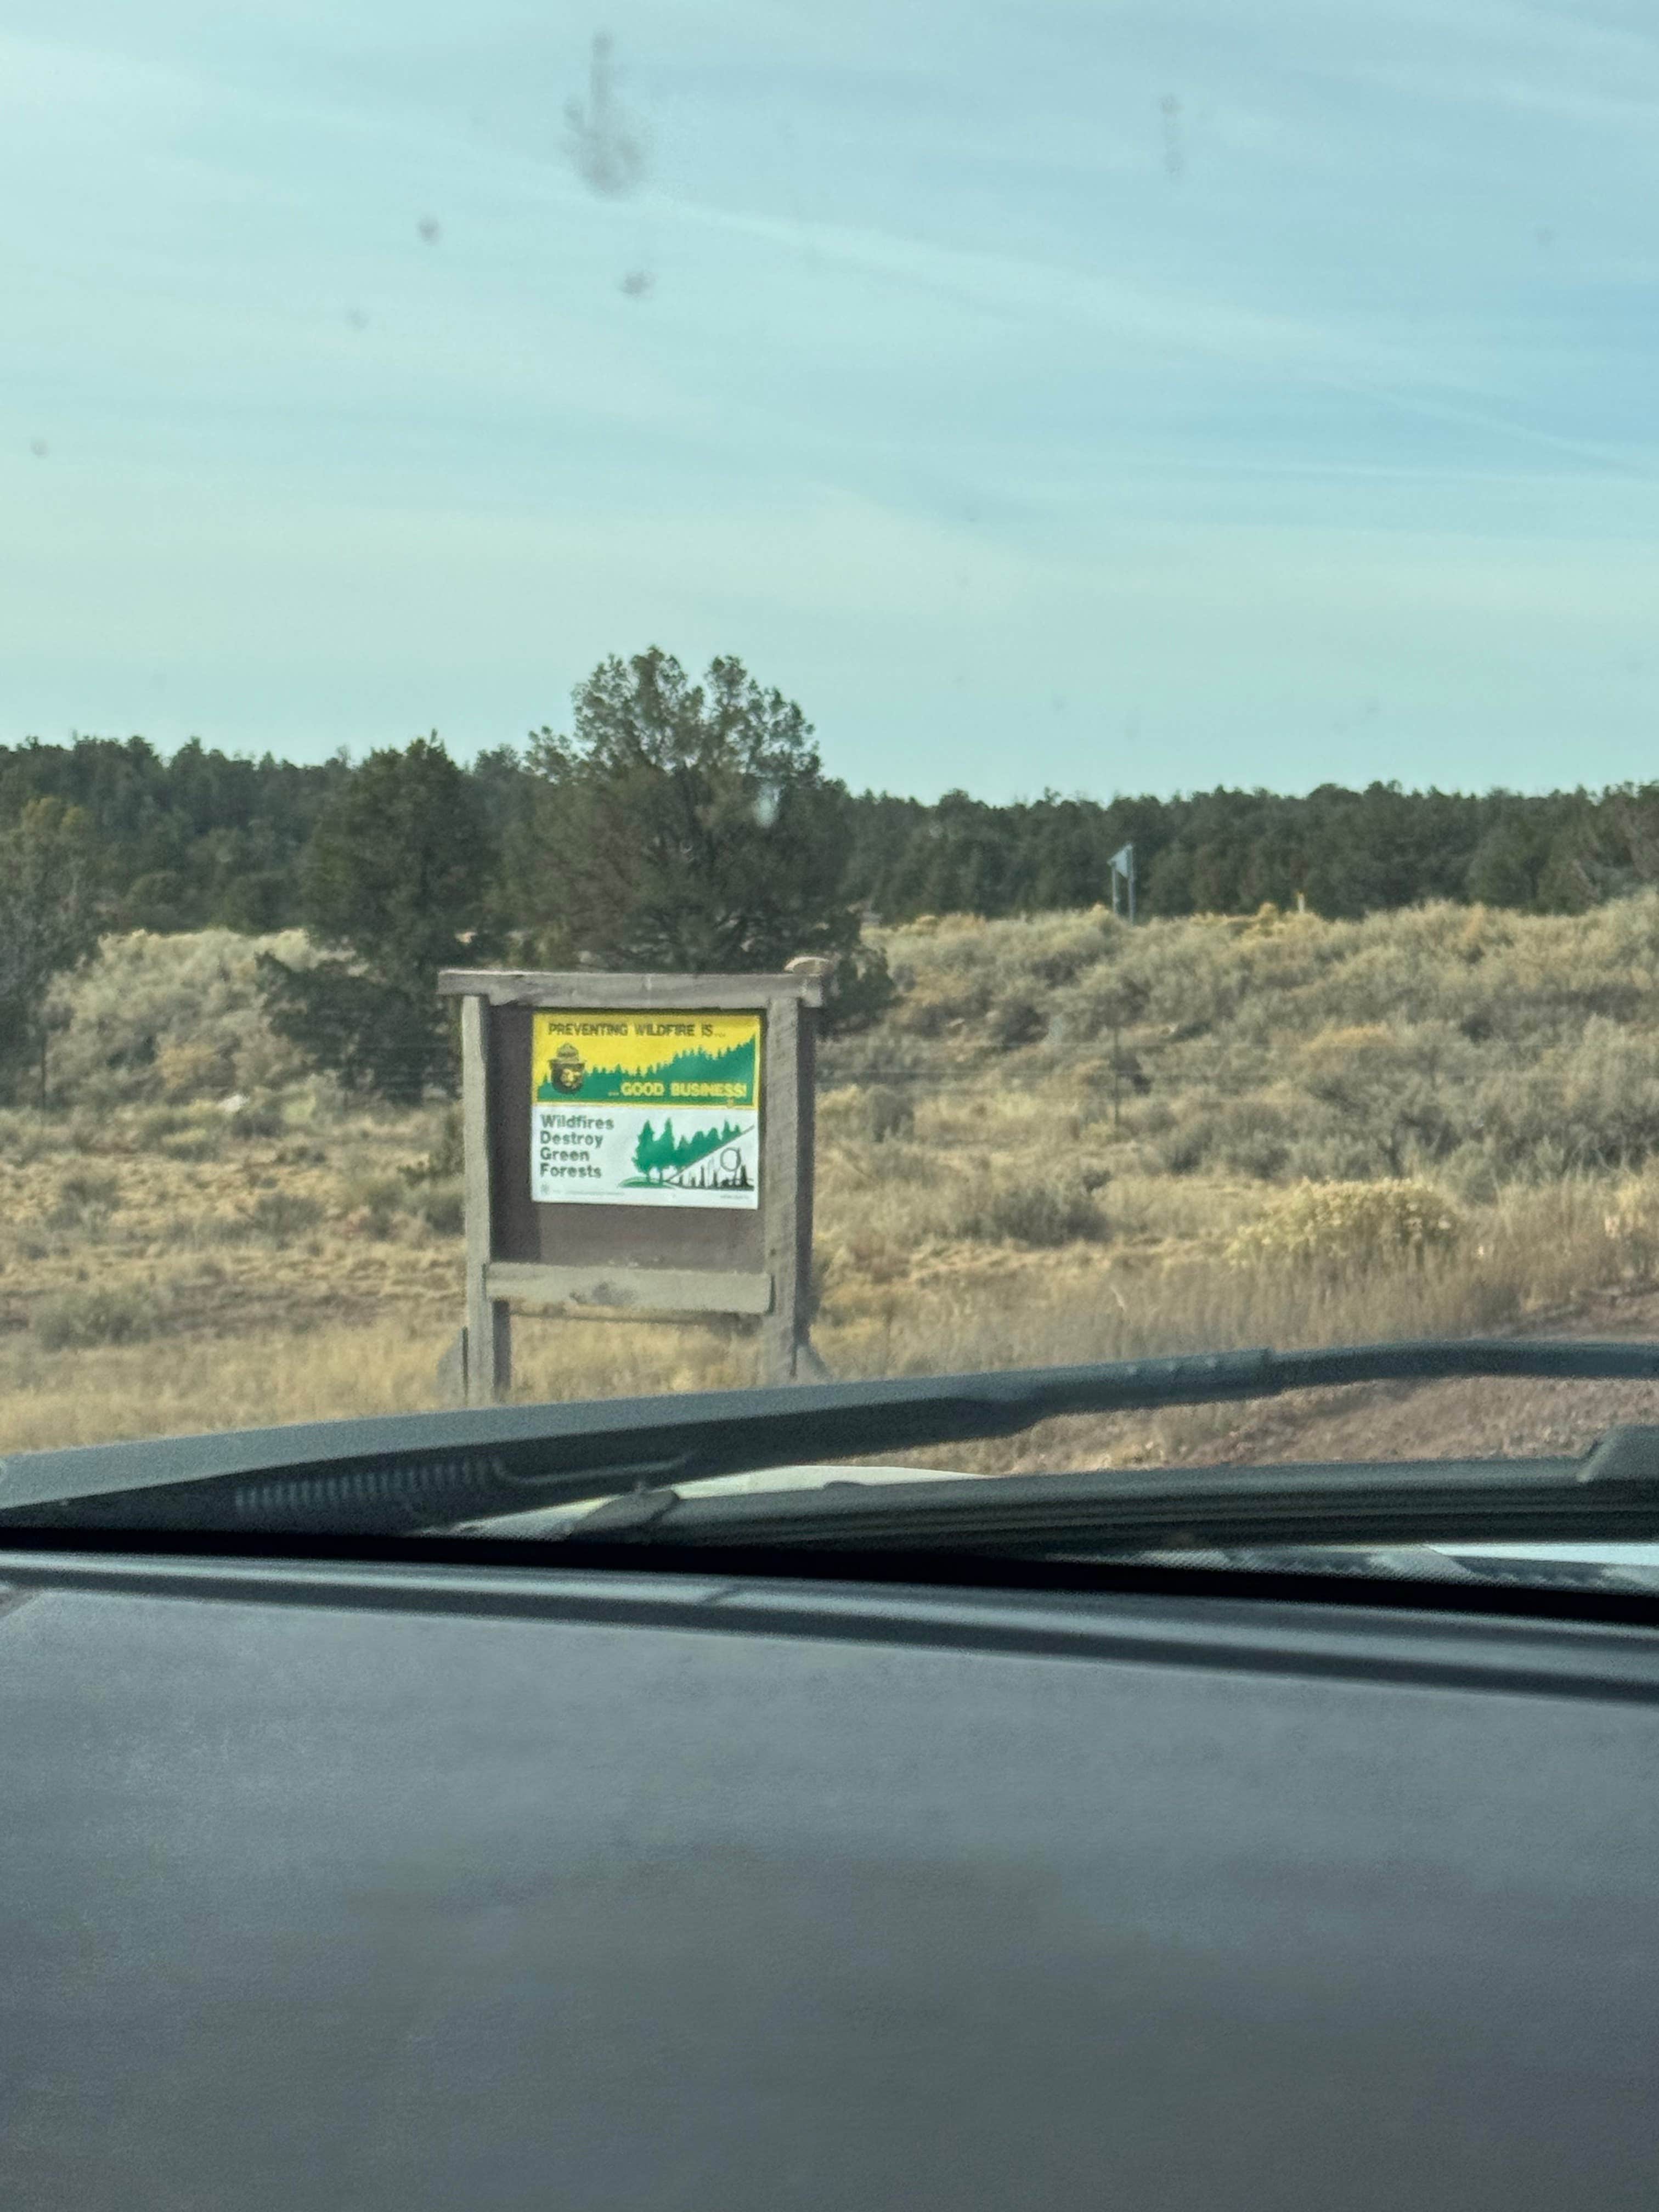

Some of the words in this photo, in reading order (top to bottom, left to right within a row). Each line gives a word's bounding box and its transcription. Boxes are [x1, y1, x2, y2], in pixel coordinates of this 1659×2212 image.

[549, 1023, 628, 1036] PREVENTING
[635, 1023, 695, 1036] WILDFIRE
[670, 1082, 747, 1097] BUSINESS!
[540, 1114, 614, 1130] Wildfires
[540, 1130, 603, 1149] Destroy
[540, 1147, 590, 1161] Green
[540, 1162, 602, 1178] Forests
